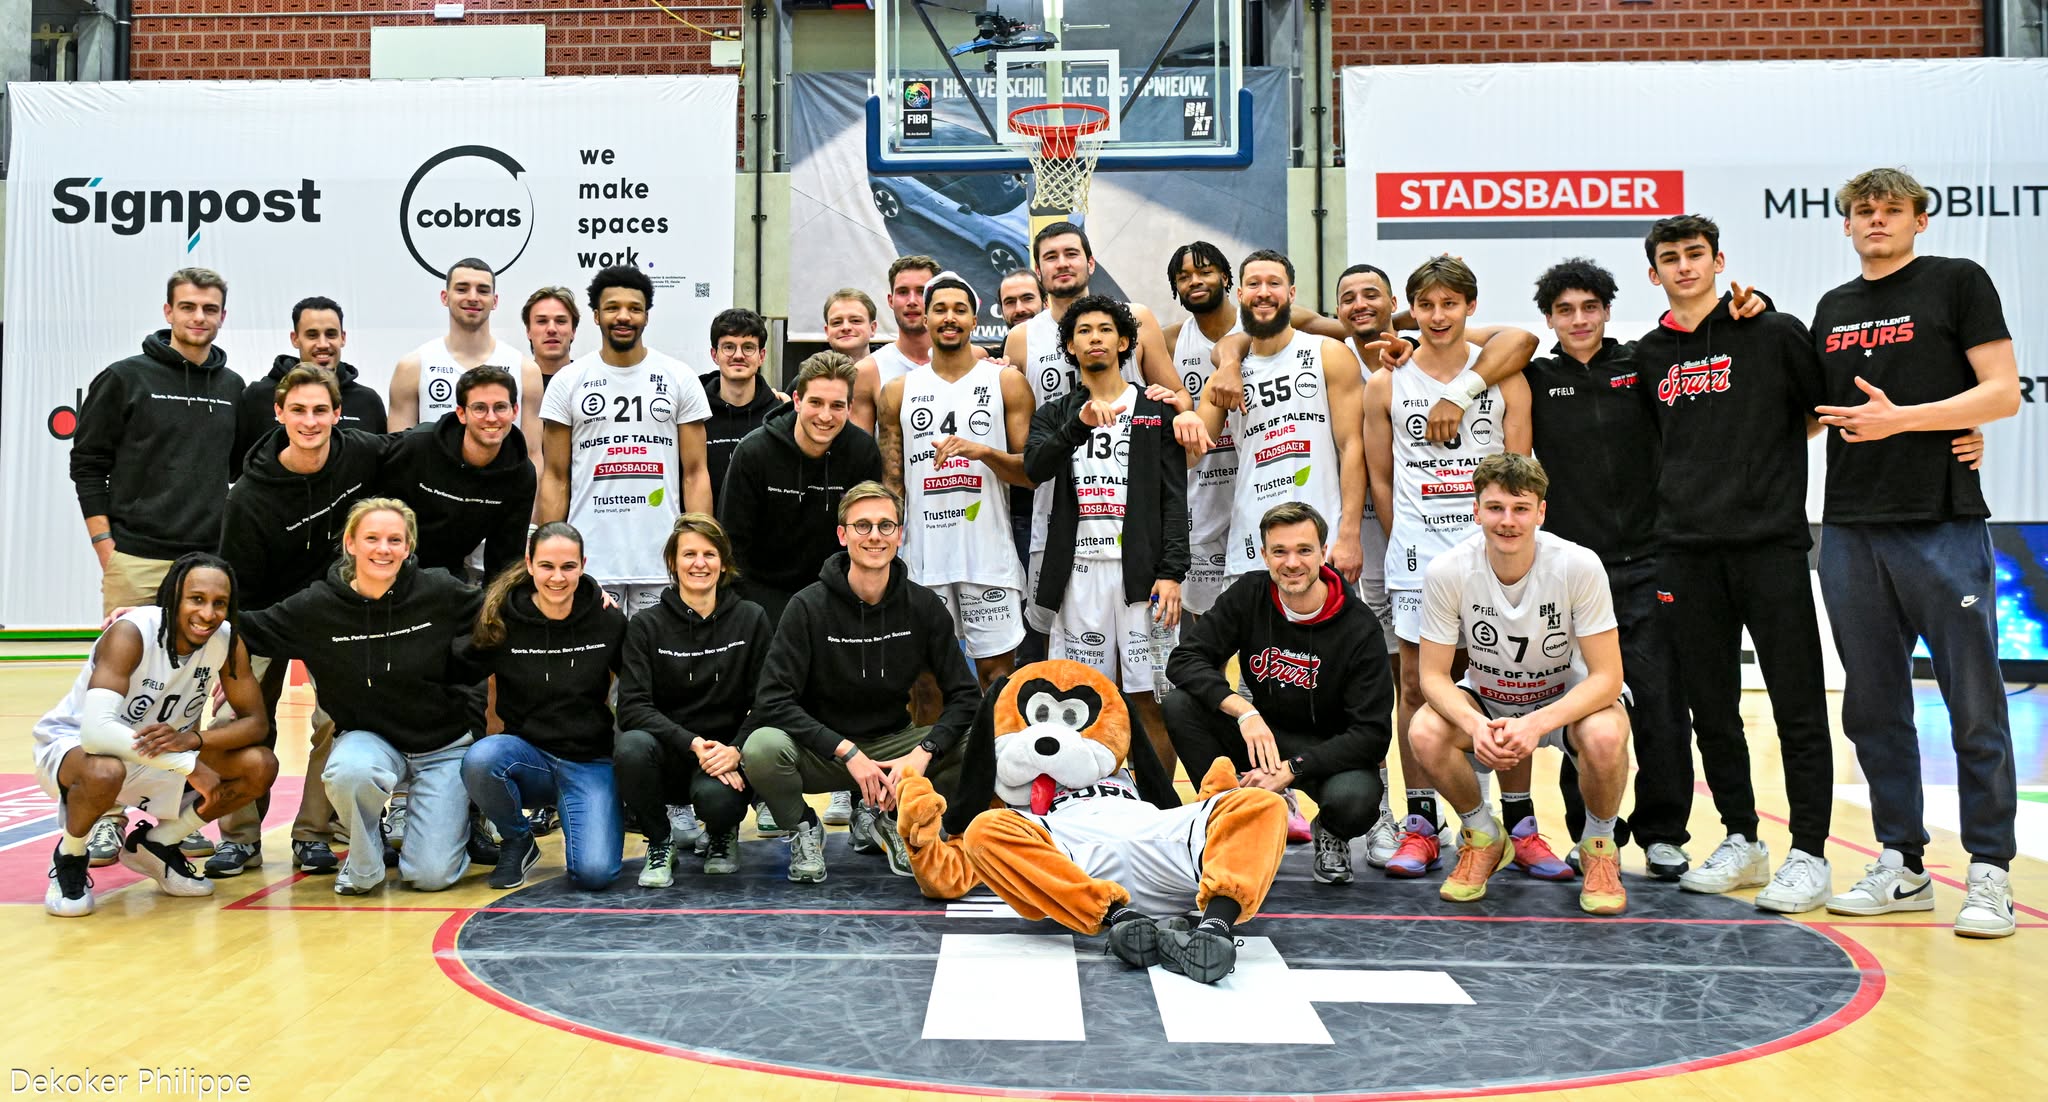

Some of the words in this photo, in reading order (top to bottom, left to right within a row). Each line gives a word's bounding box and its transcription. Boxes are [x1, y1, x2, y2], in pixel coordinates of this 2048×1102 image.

[976, 78, 1046, 98] VESCHIL
[1061, 77, 1090, 97] LKE
[1184, 102, 1206, 117] BN
[907, 114, 927, 124] FIBA
[1193, 117, 1212, 131] XT
[580, 149, 615, 165] we
[579, 178, 649, 199] make
[1400, 177, 1659, 210] STADSBADER
[1921, 185, 2048, 217] OBILIT
[52, 177, 320, 254] Signpost
[416, 202, 521, 228] cobras
[577, 217, 668, 239] spaces
[1832, 323, 1860, 333] HOUSE
[1861, 321, 1874, 329] OF
[1875, 315, 1910, 327] TALENTS
[1825, 322, 1914, 353] SPURS
[1658, 357, 1731, 406] Spurs
[1258, 375, 1292, 408] 55
[613, 395, 642, 422] 21
[939, 411, 957, 435] 4
[1131, 418, 1162, 427] SPURS
[1268, 417, 1280, 427] OF
[1282, 412, 1326, 423] TALENTS
[1264, 424, 1296, 441] SPURS
[580, 436, 611, 450] HOUSE
[613, 435, 629, 444] OF
[632, 435, 673, 447] TALENTS
[1087, 432, 1112, 460] 13
[607, 446, 648, 456] SPURS
[598, 463, 659, 474] STADSBADER
[941, 459, 970, 470] PURS
[1439, 459, 1454, 467] OF
[925, 476, 978, 488] STADSBADER
[1083, 475, 1097, 485] OF
[1077, 487, 1115, 497] SPURS
[593, 495, 646, 506] Trustteam
[1548, 612, 1561, 625] XT
[1507, 635, 1529, 663] 7
[1249, 647, 1321, 689] Spurs
[1504, 671, 1523, 679] OF
[1497, 679, 1546, 688] SPURS
[1486, 686, 1558, 702] STADSBADER
